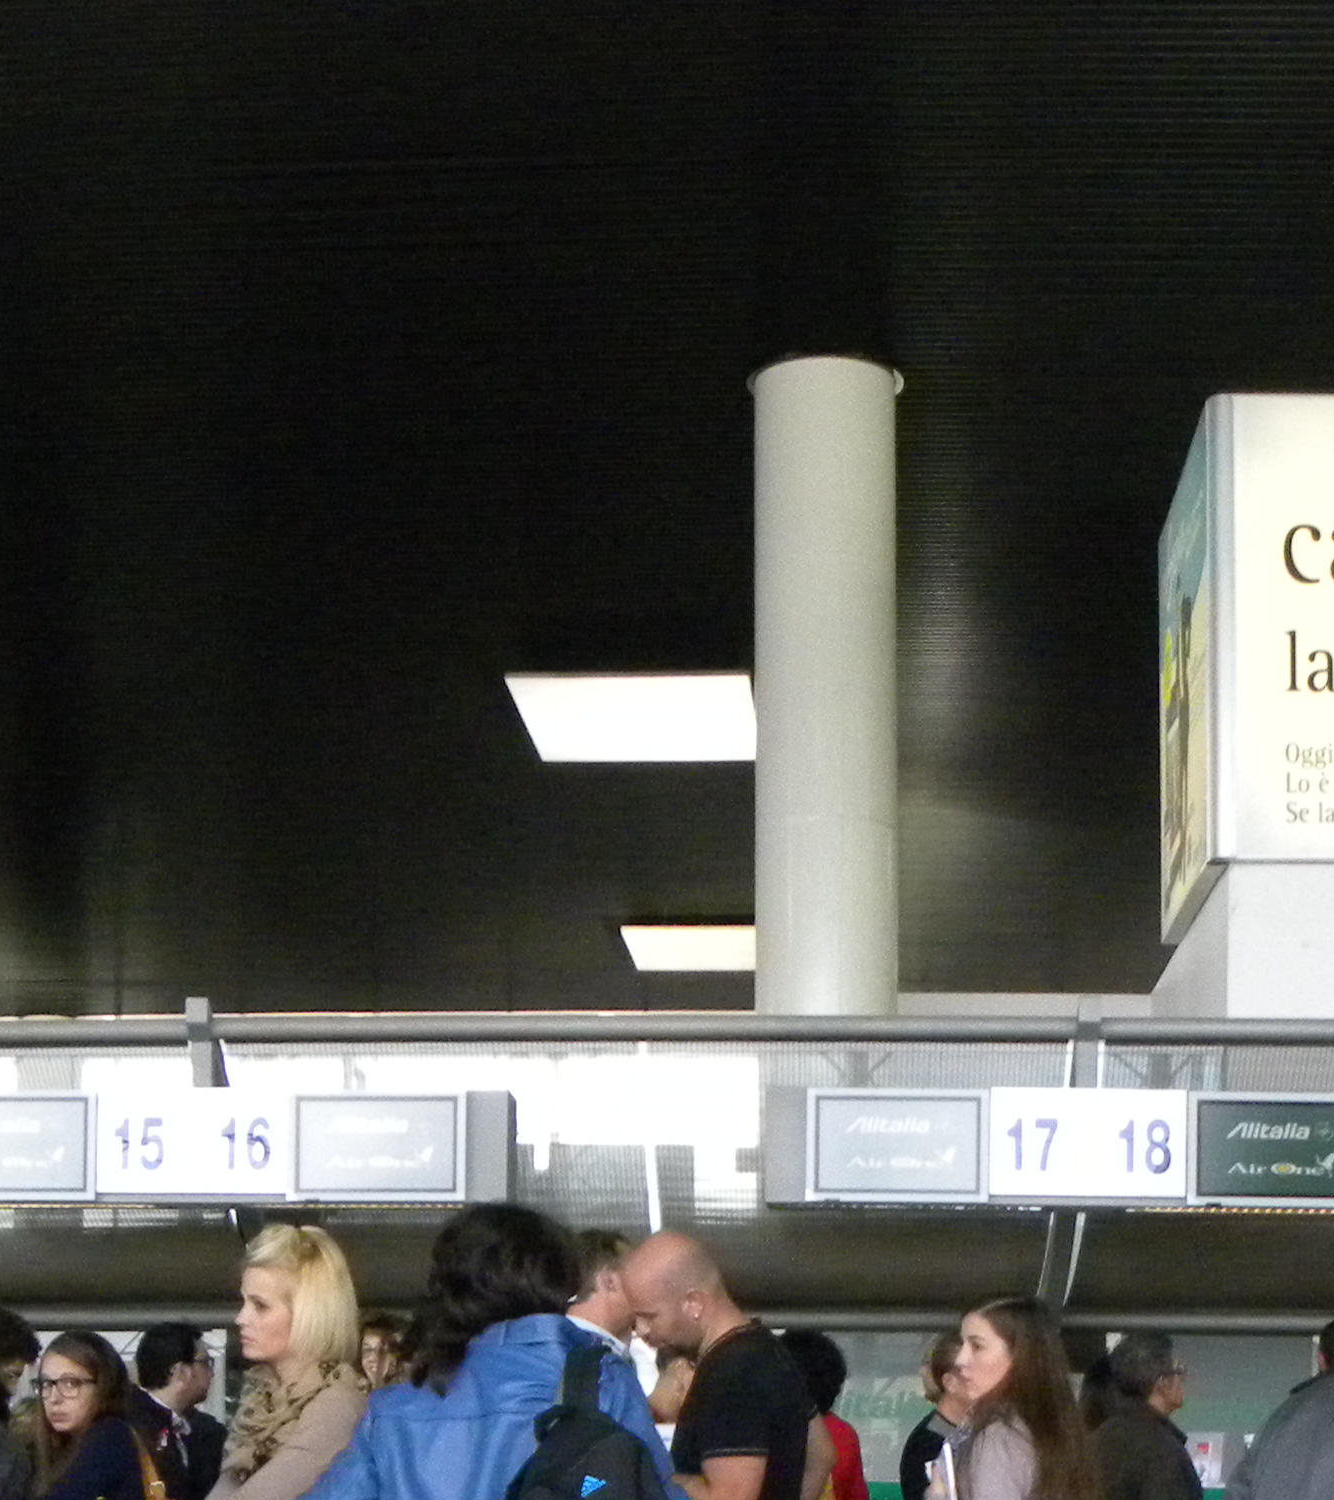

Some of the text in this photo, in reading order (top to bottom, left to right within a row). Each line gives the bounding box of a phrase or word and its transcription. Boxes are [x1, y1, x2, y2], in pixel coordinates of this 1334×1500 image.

[1285, 742, 1333, 769] Oggi
[1285, 772, 1310, 793] Lo
[1285, 801, 1310, 823] Se
[845, 1115, 931, 1134] Alitalia
[1226, 1120, 1311, 1140] Alitalia
[114, 1117, 271, 1170] 15 16
[1006, 1117, 1172, 1175] 17 18
